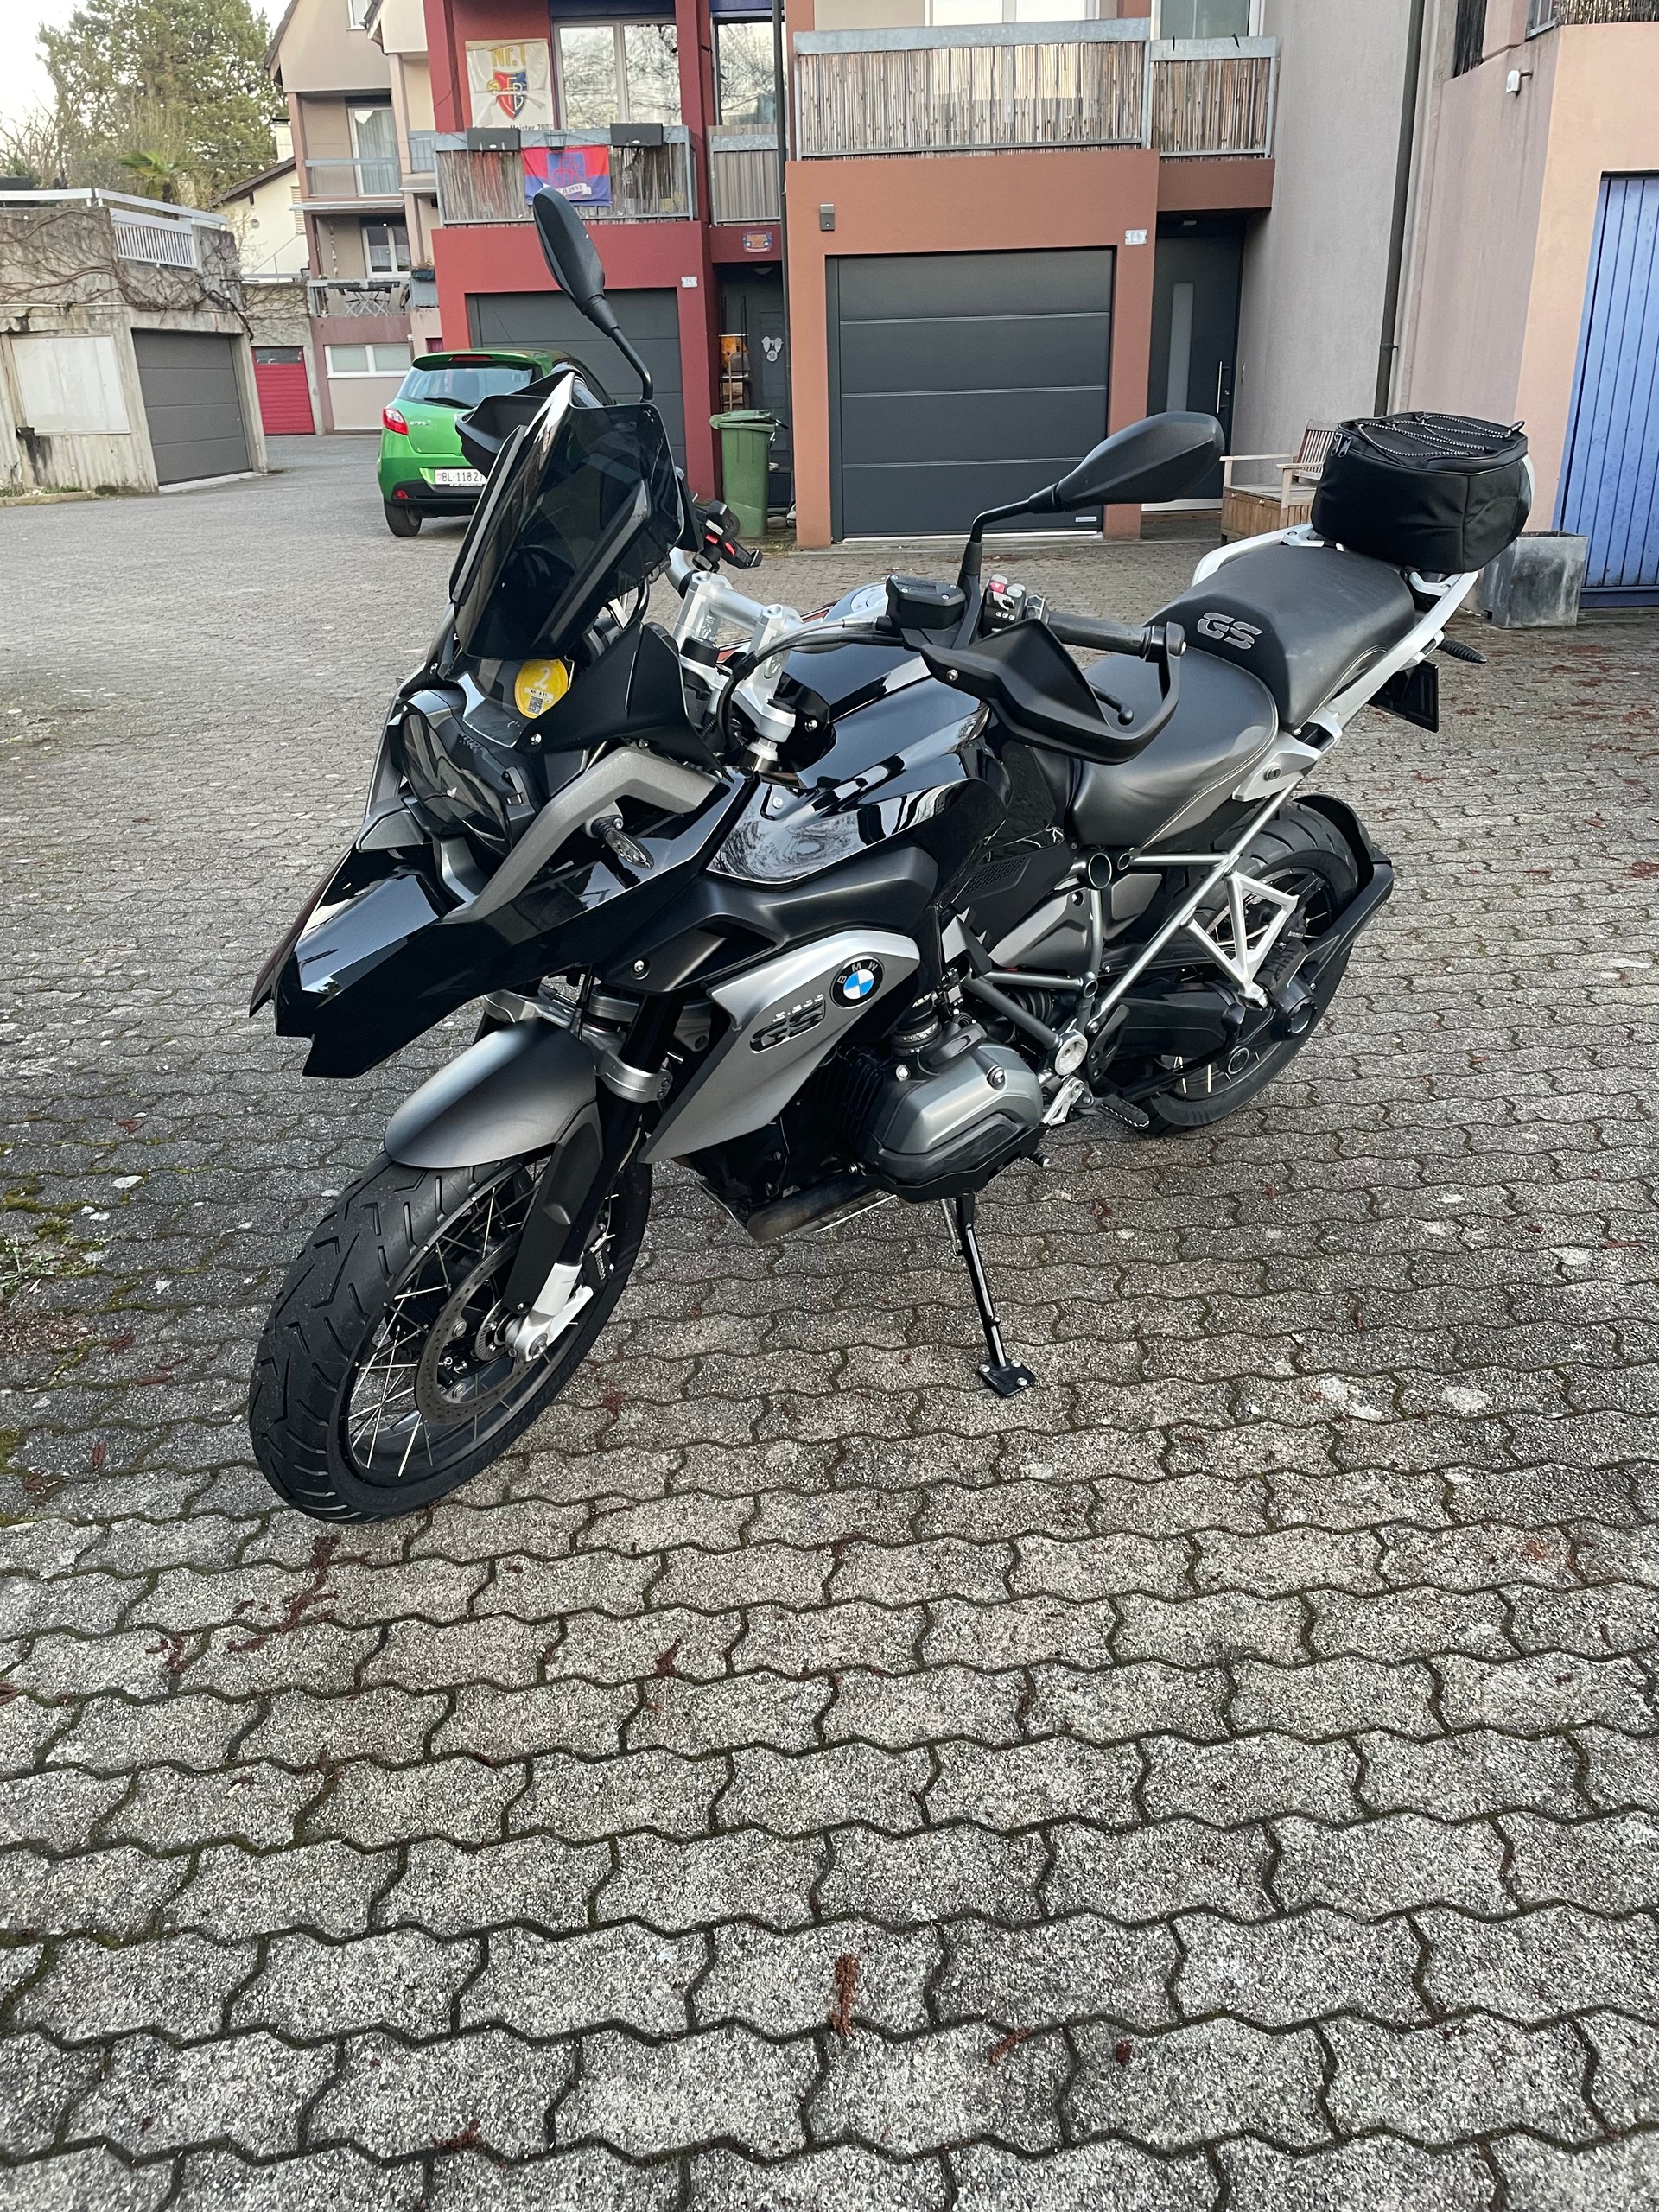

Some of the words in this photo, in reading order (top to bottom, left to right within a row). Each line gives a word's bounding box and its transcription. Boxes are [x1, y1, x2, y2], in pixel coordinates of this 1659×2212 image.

[1197, 612, 1263, 650] GS
[534, 666, 551, 690] 2
[836, 961, 878, 984] BMW
[750, 999, 826, 1053] GS
